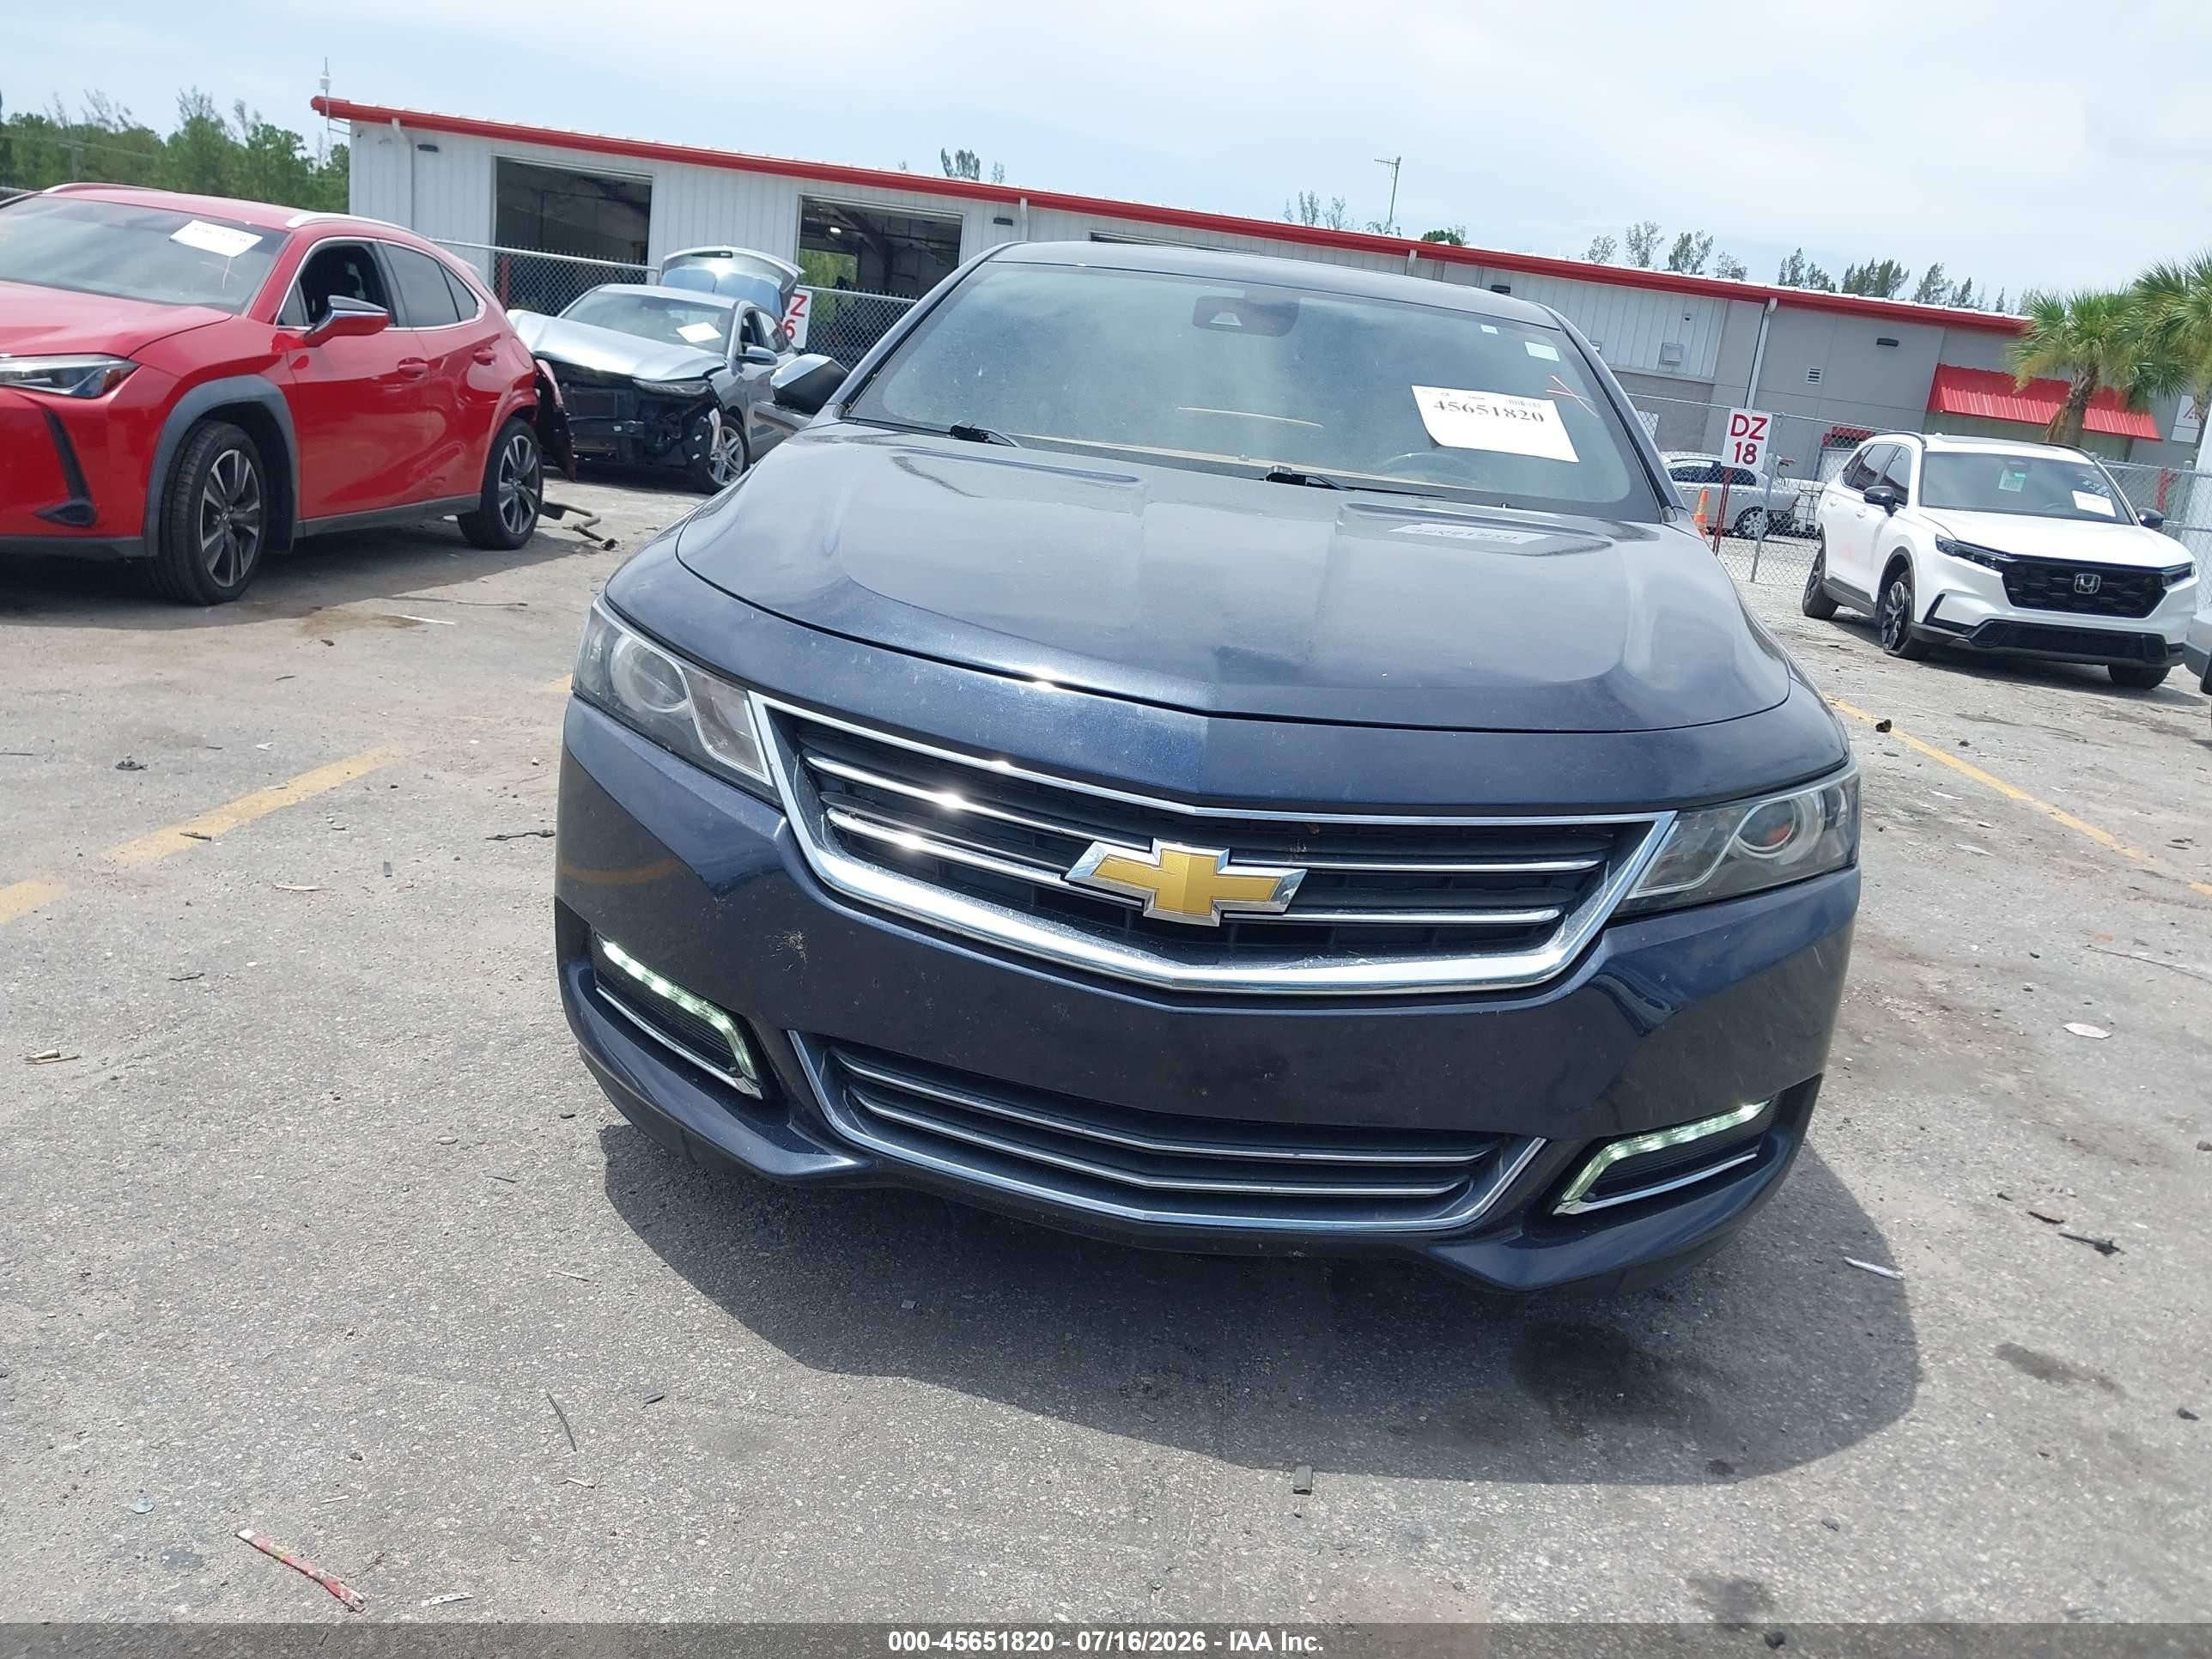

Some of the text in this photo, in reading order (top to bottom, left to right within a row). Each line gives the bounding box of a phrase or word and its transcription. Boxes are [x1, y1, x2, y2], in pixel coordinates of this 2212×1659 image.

[789, 294, 808, 318] Z
[1433, 399, 1545, 422] 45651820
[1730, 414, 1768, 441] DZ
[1735, 441, 1757, 465] 18
